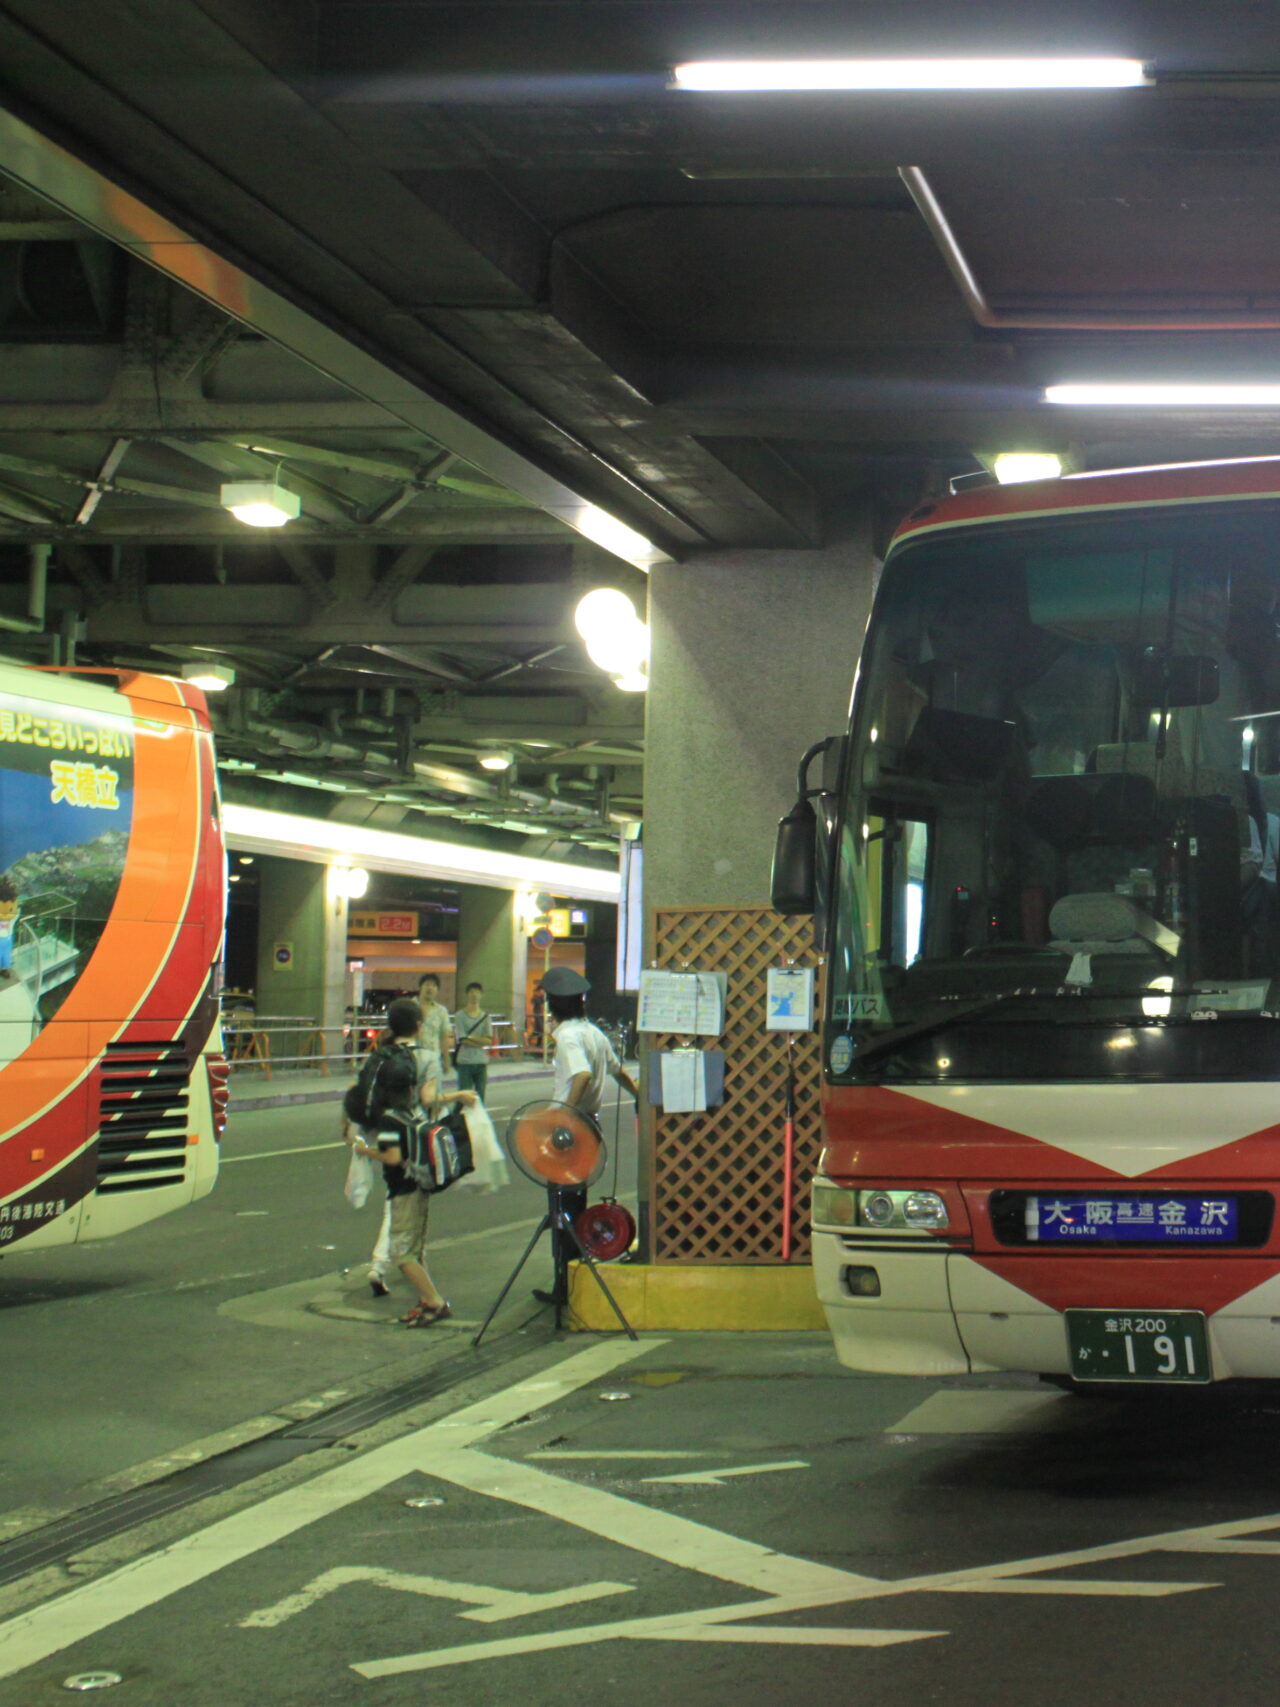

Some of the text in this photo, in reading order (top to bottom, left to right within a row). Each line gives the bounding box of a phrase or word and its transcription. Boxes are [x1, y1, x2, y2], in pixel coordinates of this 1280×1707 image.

[50, 760, 119, 809] 天橋立
[0, 1225, 14, 1240] 03
[1060, 1225, 1223, 1236] Osaka Kanazawa
